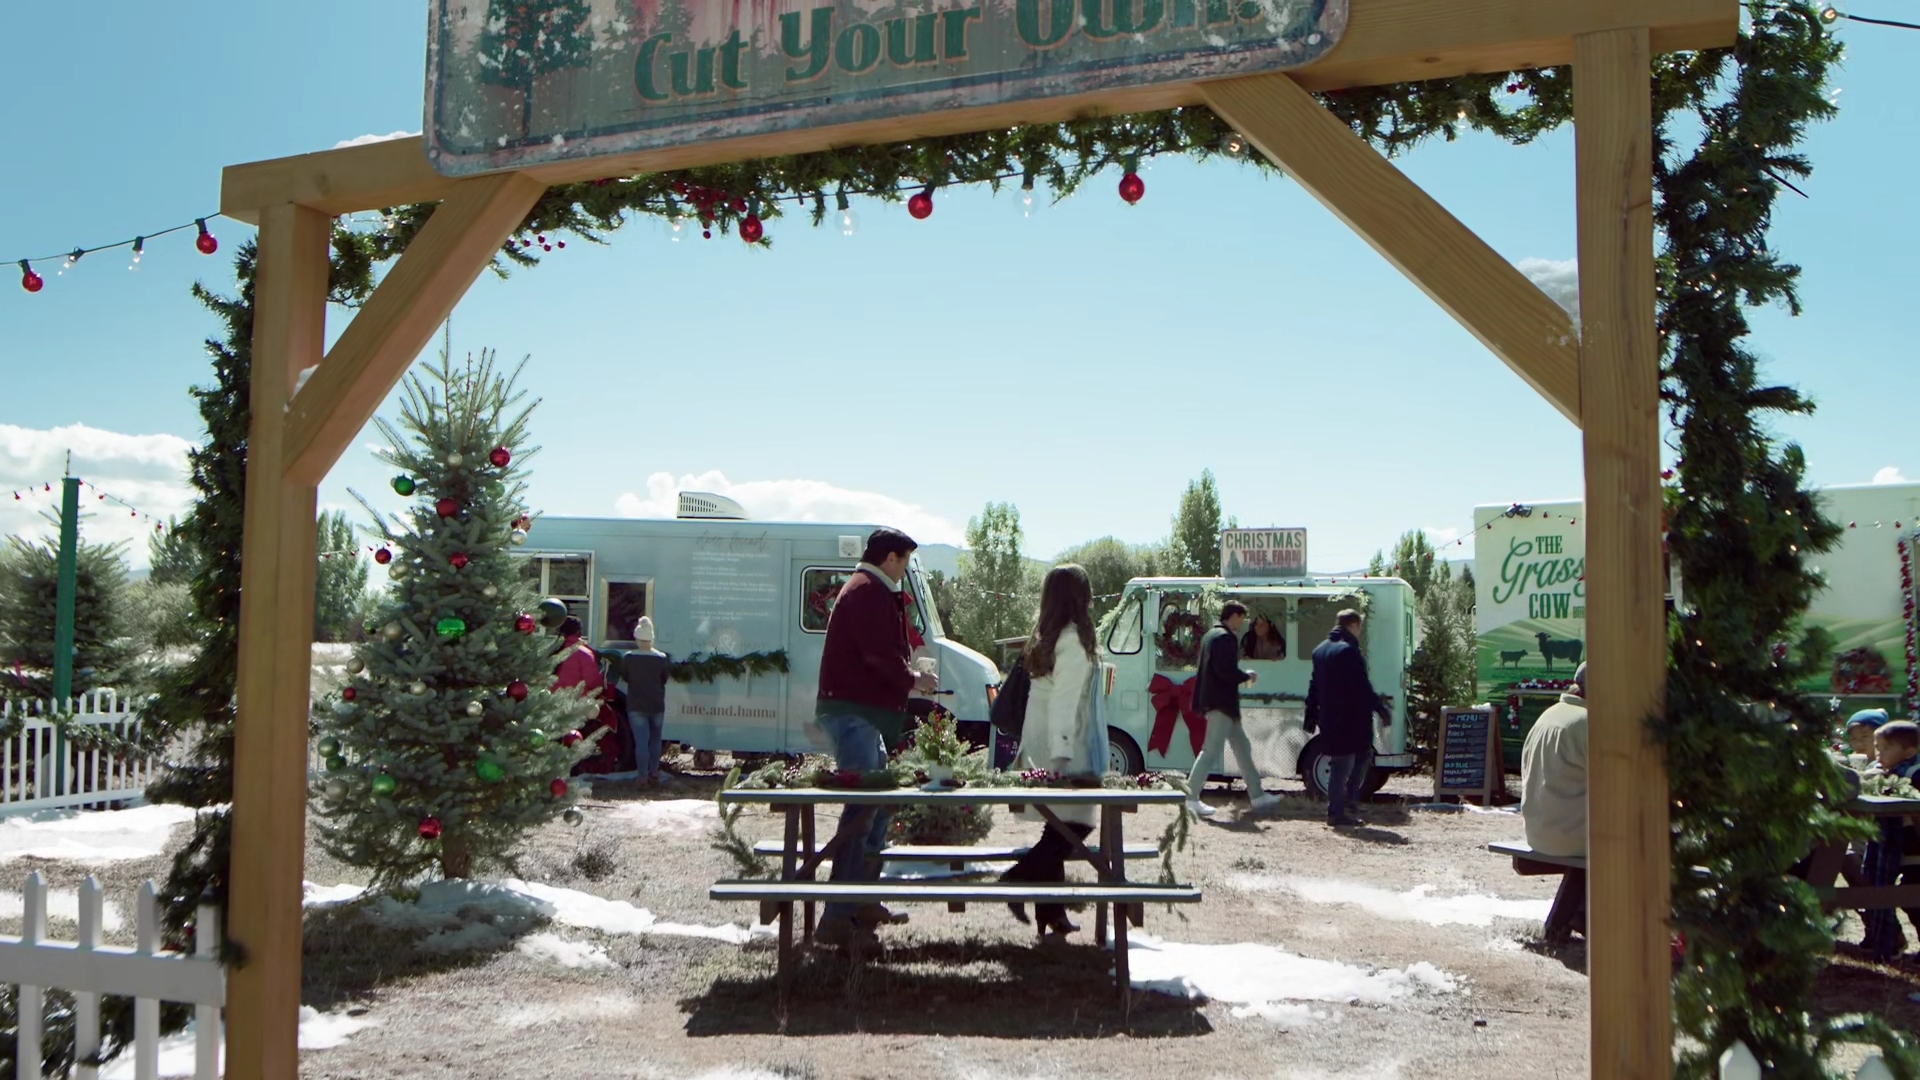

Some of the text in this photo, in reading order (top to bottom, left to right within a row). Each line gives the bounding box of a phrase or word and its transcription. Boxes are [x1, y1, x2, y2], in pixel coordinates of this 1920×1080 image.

[633, 0, 1264, 101] Cut Your Own
[1226, 532, 1302, 549] CHRISTMAS
[1535, 535, 1562, 554] THE
[1242, 550, 1301, 566] TREE FARM
[1493, 536, 1585, 604] Grass
[1529, 593, 1571, 619] COW
[681, 704, 776, 719] tate.and.hanna
[1456, 714, 1478, 722] MENU
